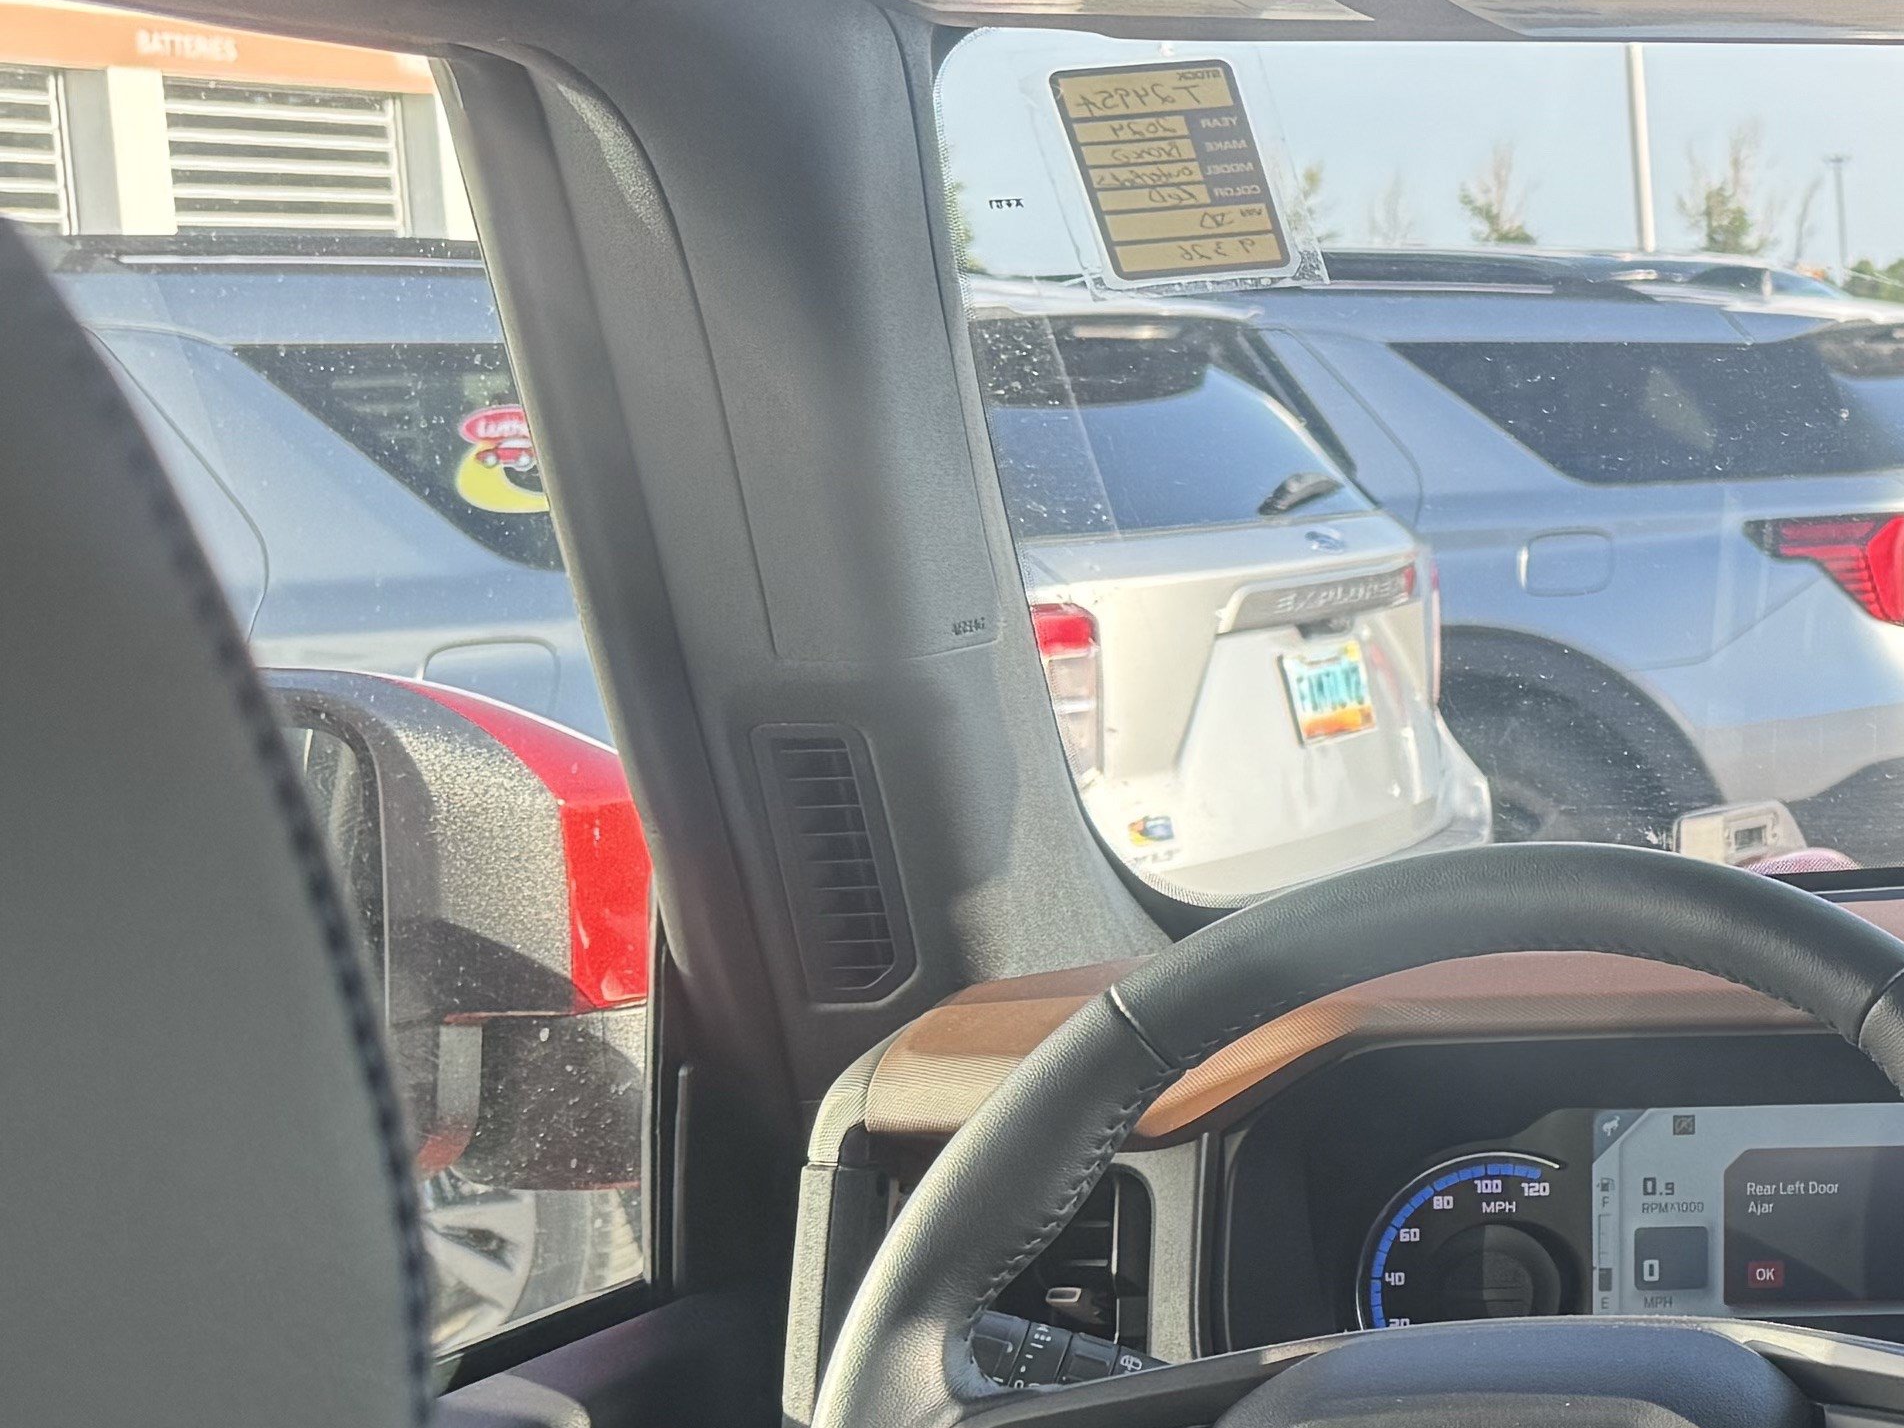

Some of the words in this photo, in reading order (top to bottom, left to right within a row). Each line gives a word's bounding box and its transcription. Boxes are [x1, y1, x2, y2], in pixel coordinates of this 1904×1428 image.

[136, 29, 238, 62] BATTERIES
[1473, 1179, 1503, 1194] 100
[1521, 1182, 1550, 1197] 120
[1746, 1182, 1776, 1196] Rear
[1780, 1181, 1805, 1195] Left
[1809, 1180, 1839, 1195] Door
[1433, 1196, 1454, 1210] 80
[1482, 1201, 1517, 1214] MPH
[1748, 1200, 1775, 1215] Ajar
[1399, 1228, 1421, 1243] 60
[1384, 1272, 1406, 1286] 40
[1755, 1267, 1775, 1282] OK
[1643, 1296, 1673, 1309] MPH
